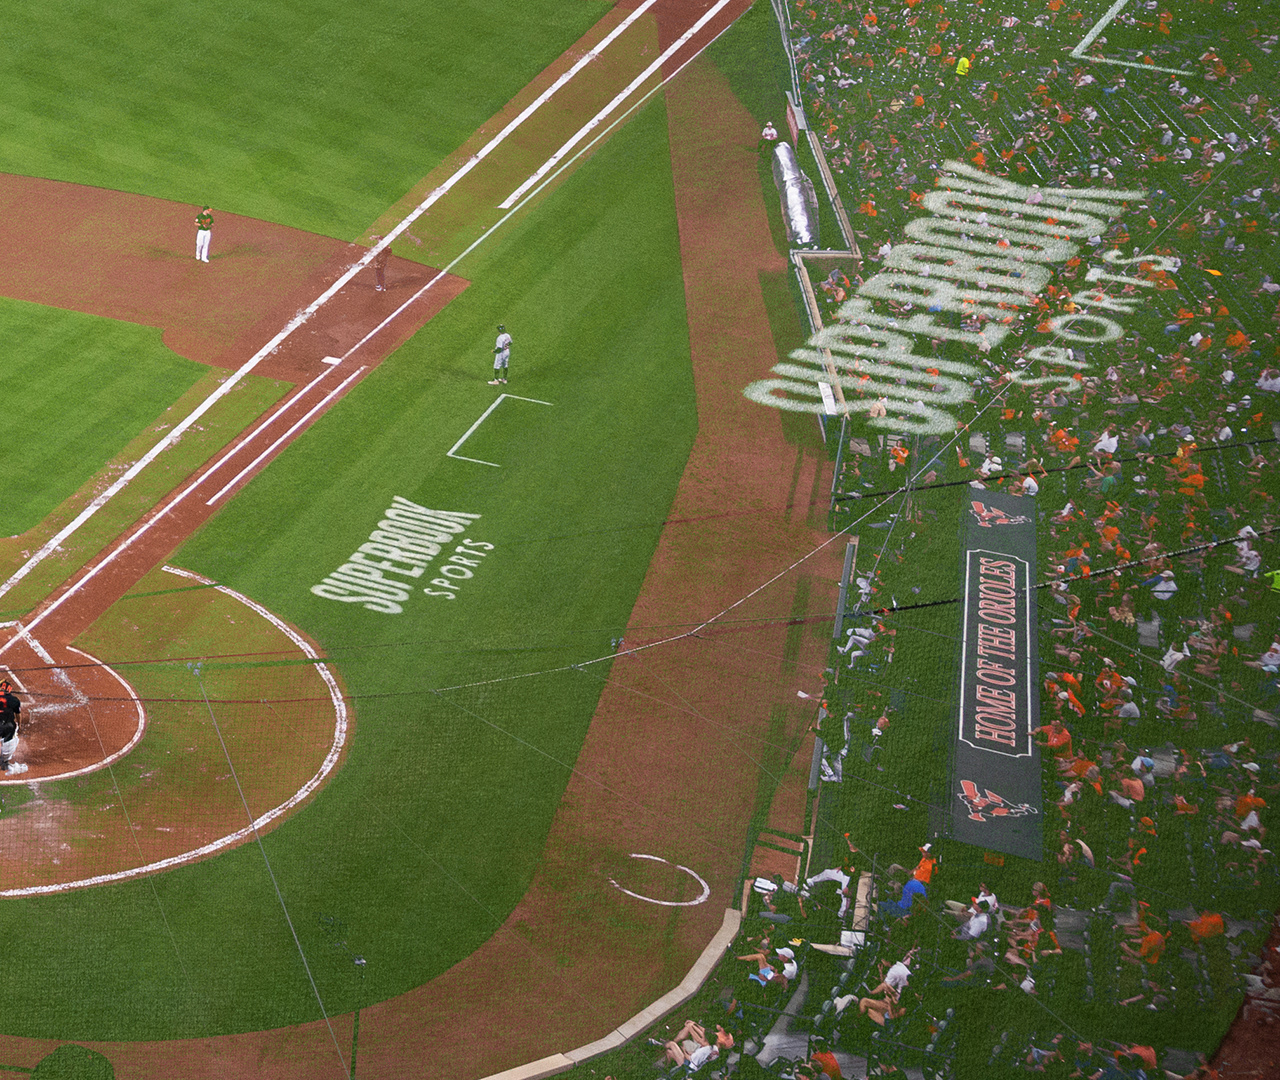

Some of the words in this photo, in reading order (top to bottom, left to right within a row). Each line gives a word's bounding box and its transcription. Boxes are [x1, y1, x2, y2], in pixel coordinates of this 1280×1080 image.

[741, 158, 1149, 436] SUPERBOOK
[1007, 248, 1181, 393] SPORTS
[310, 495, 482, 614] SUPERBOOK
[423, 538, 494, 600] SPORTS
[977, 557, 1016, 625] ORIOLES
[975, 659, 1016, 686] OF
[976, 624, 1016, 660] THE
[974, 685, 1016, 747] HOME
